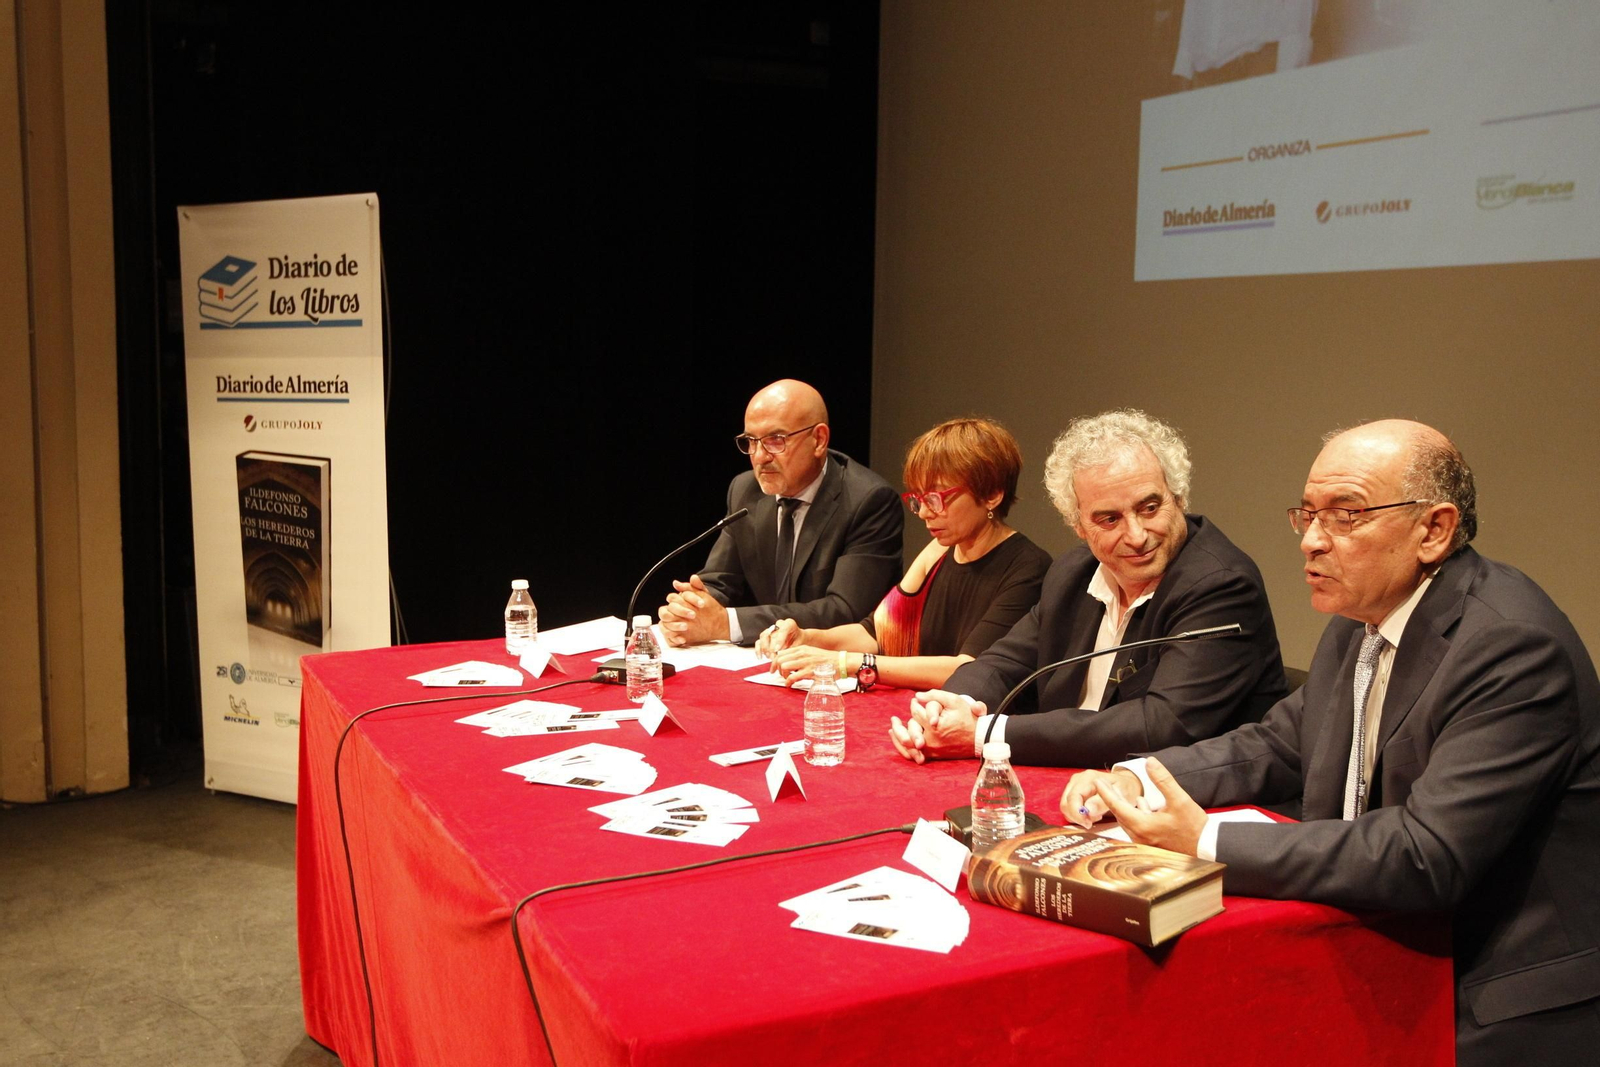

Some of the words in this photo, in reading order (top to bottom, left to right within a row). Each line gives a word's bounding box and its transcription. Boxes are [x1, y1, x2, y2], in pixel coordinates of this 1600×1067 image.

[1247, 140, 1311, 162] ORGANIZA
[1163, 206, 1202, 228] Diario
[1203, 205, 1219, 224] de
[1220, 199, 1276, 222] Almería
[268, 253, 332, 279] Diario
[335, 253, 359, 277] de
[269, 290, 297, 316] los
[300, 287, 361, 323] Libros
[216, 374, 264, 394] Diario
[265, 375, 284, 393] de
[285, 374, 350, 394] Almería
[249, 487, 302, 504] ILDEFONSO
[244, 496, 309, 519] FALCONES
[240, 516, 257, 528] LOS
[258, 518, 316, 539] HEREDEROS
[245, 527, 258, 538] DE
[260, 530, 272, 542] LA
[273, 533, 310, 550] TIERRA
[223, 715, 260, 726] MICHELIN
